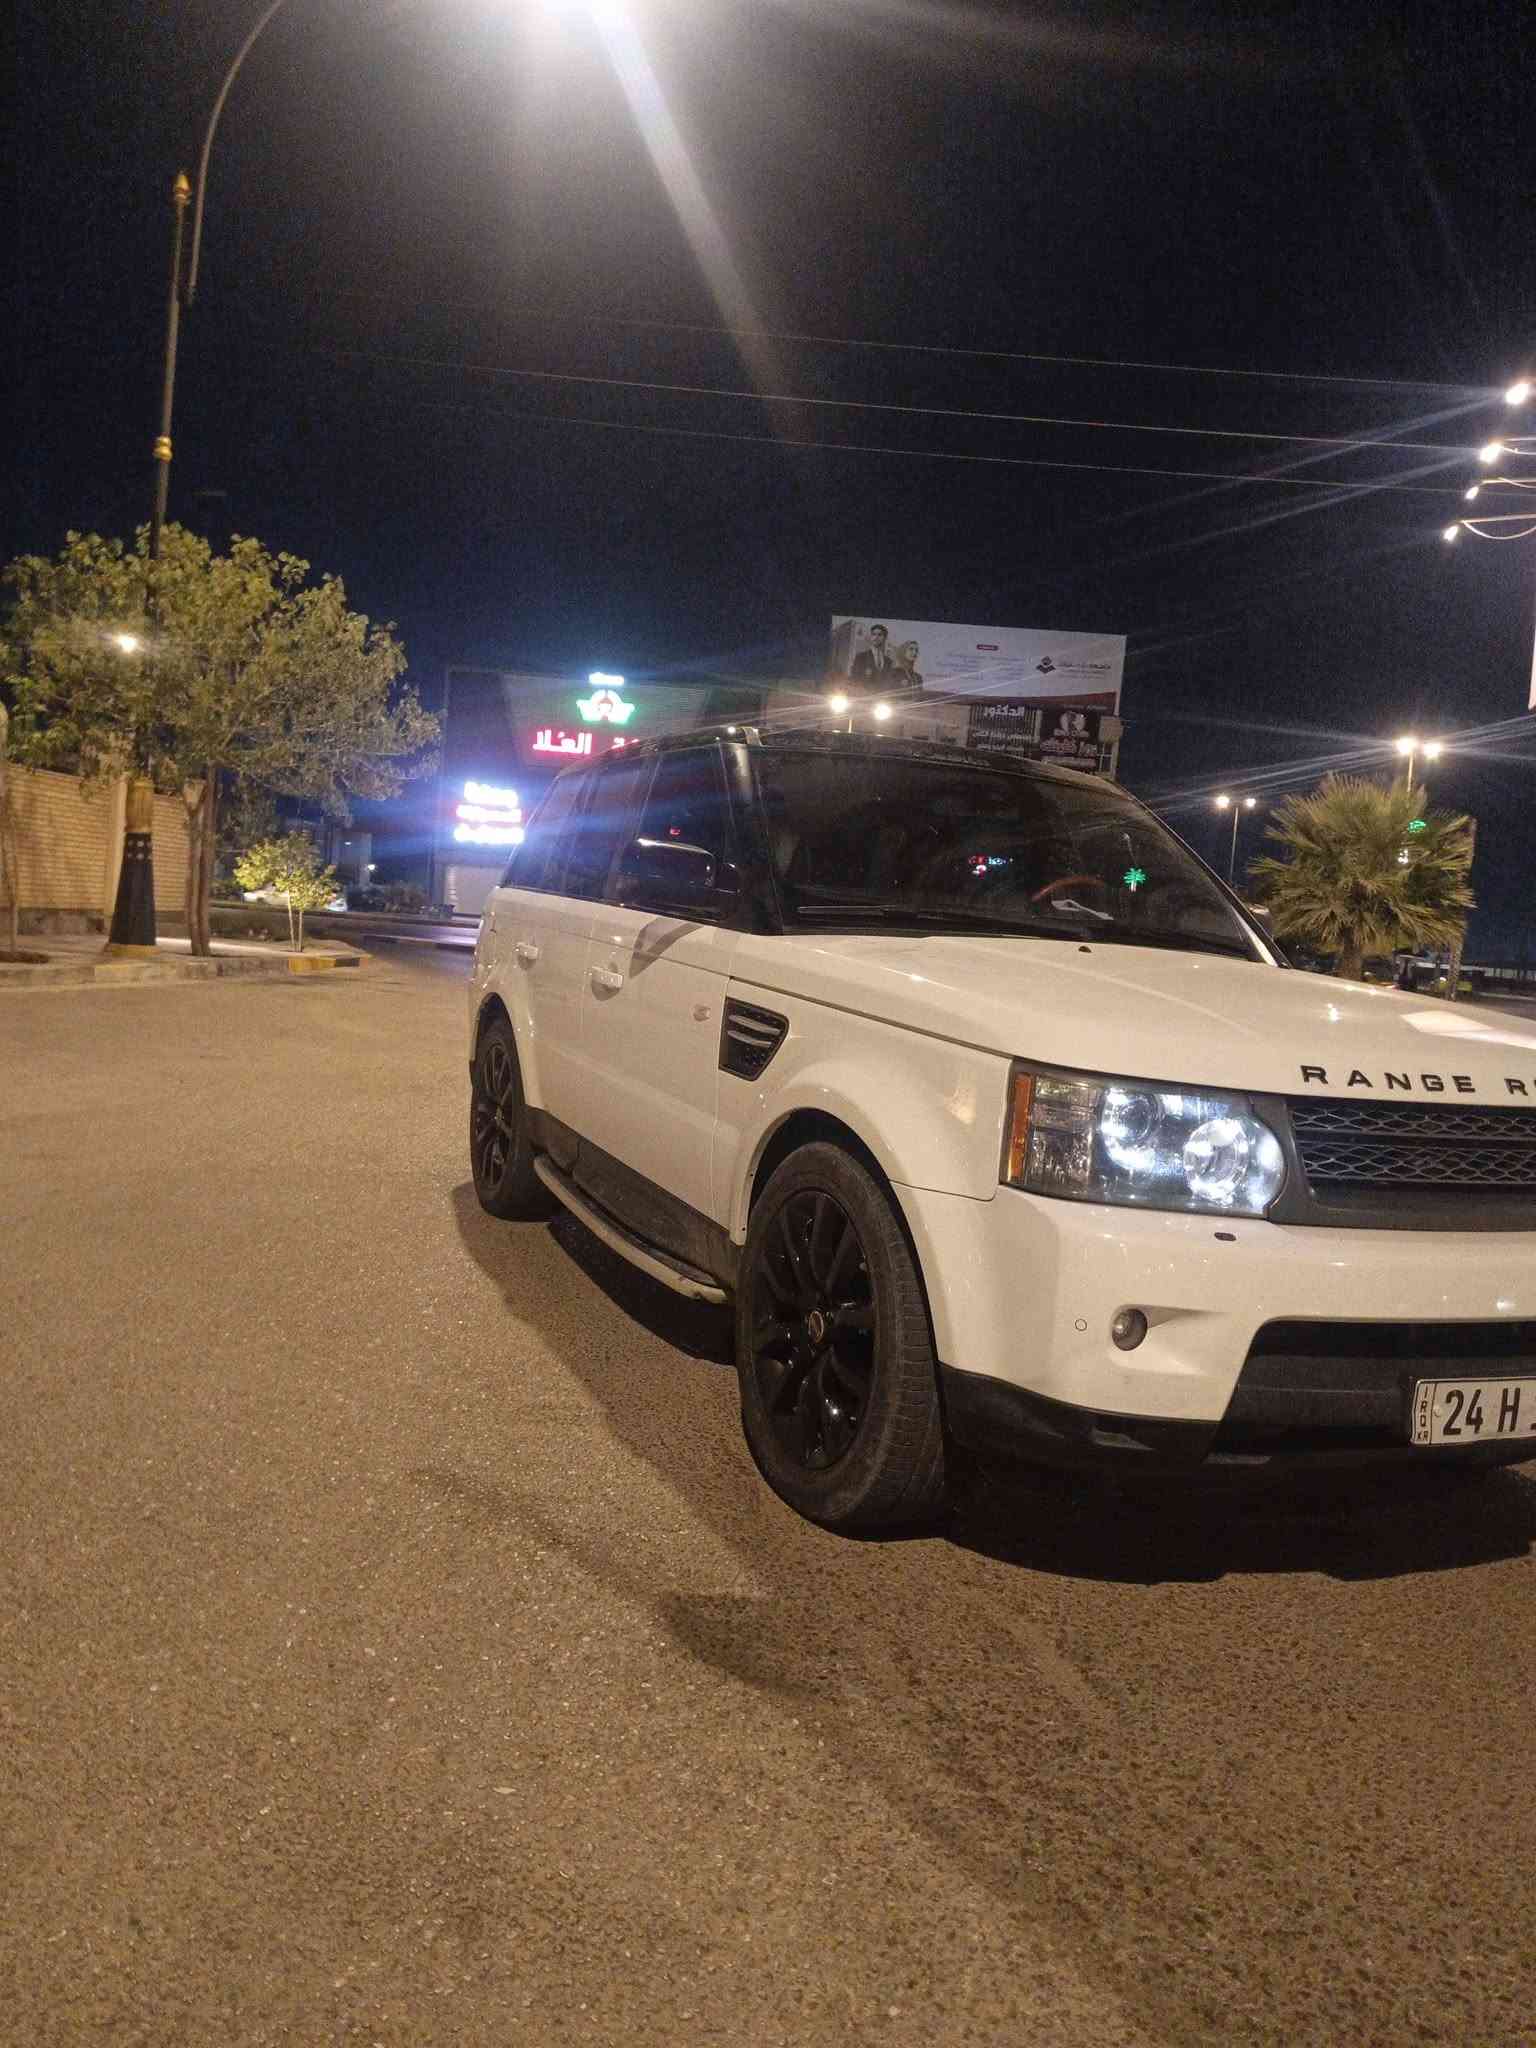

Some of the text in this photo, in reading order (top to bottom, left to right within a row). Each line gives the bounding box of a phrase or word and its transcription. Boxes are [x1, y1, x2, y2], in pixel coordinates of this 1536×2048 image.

[1301, 1065, 1536, 1096] RANGE R
[1443, 1389, 1483, 1435] 24
[1497, 1388, 1520, 1432] H
